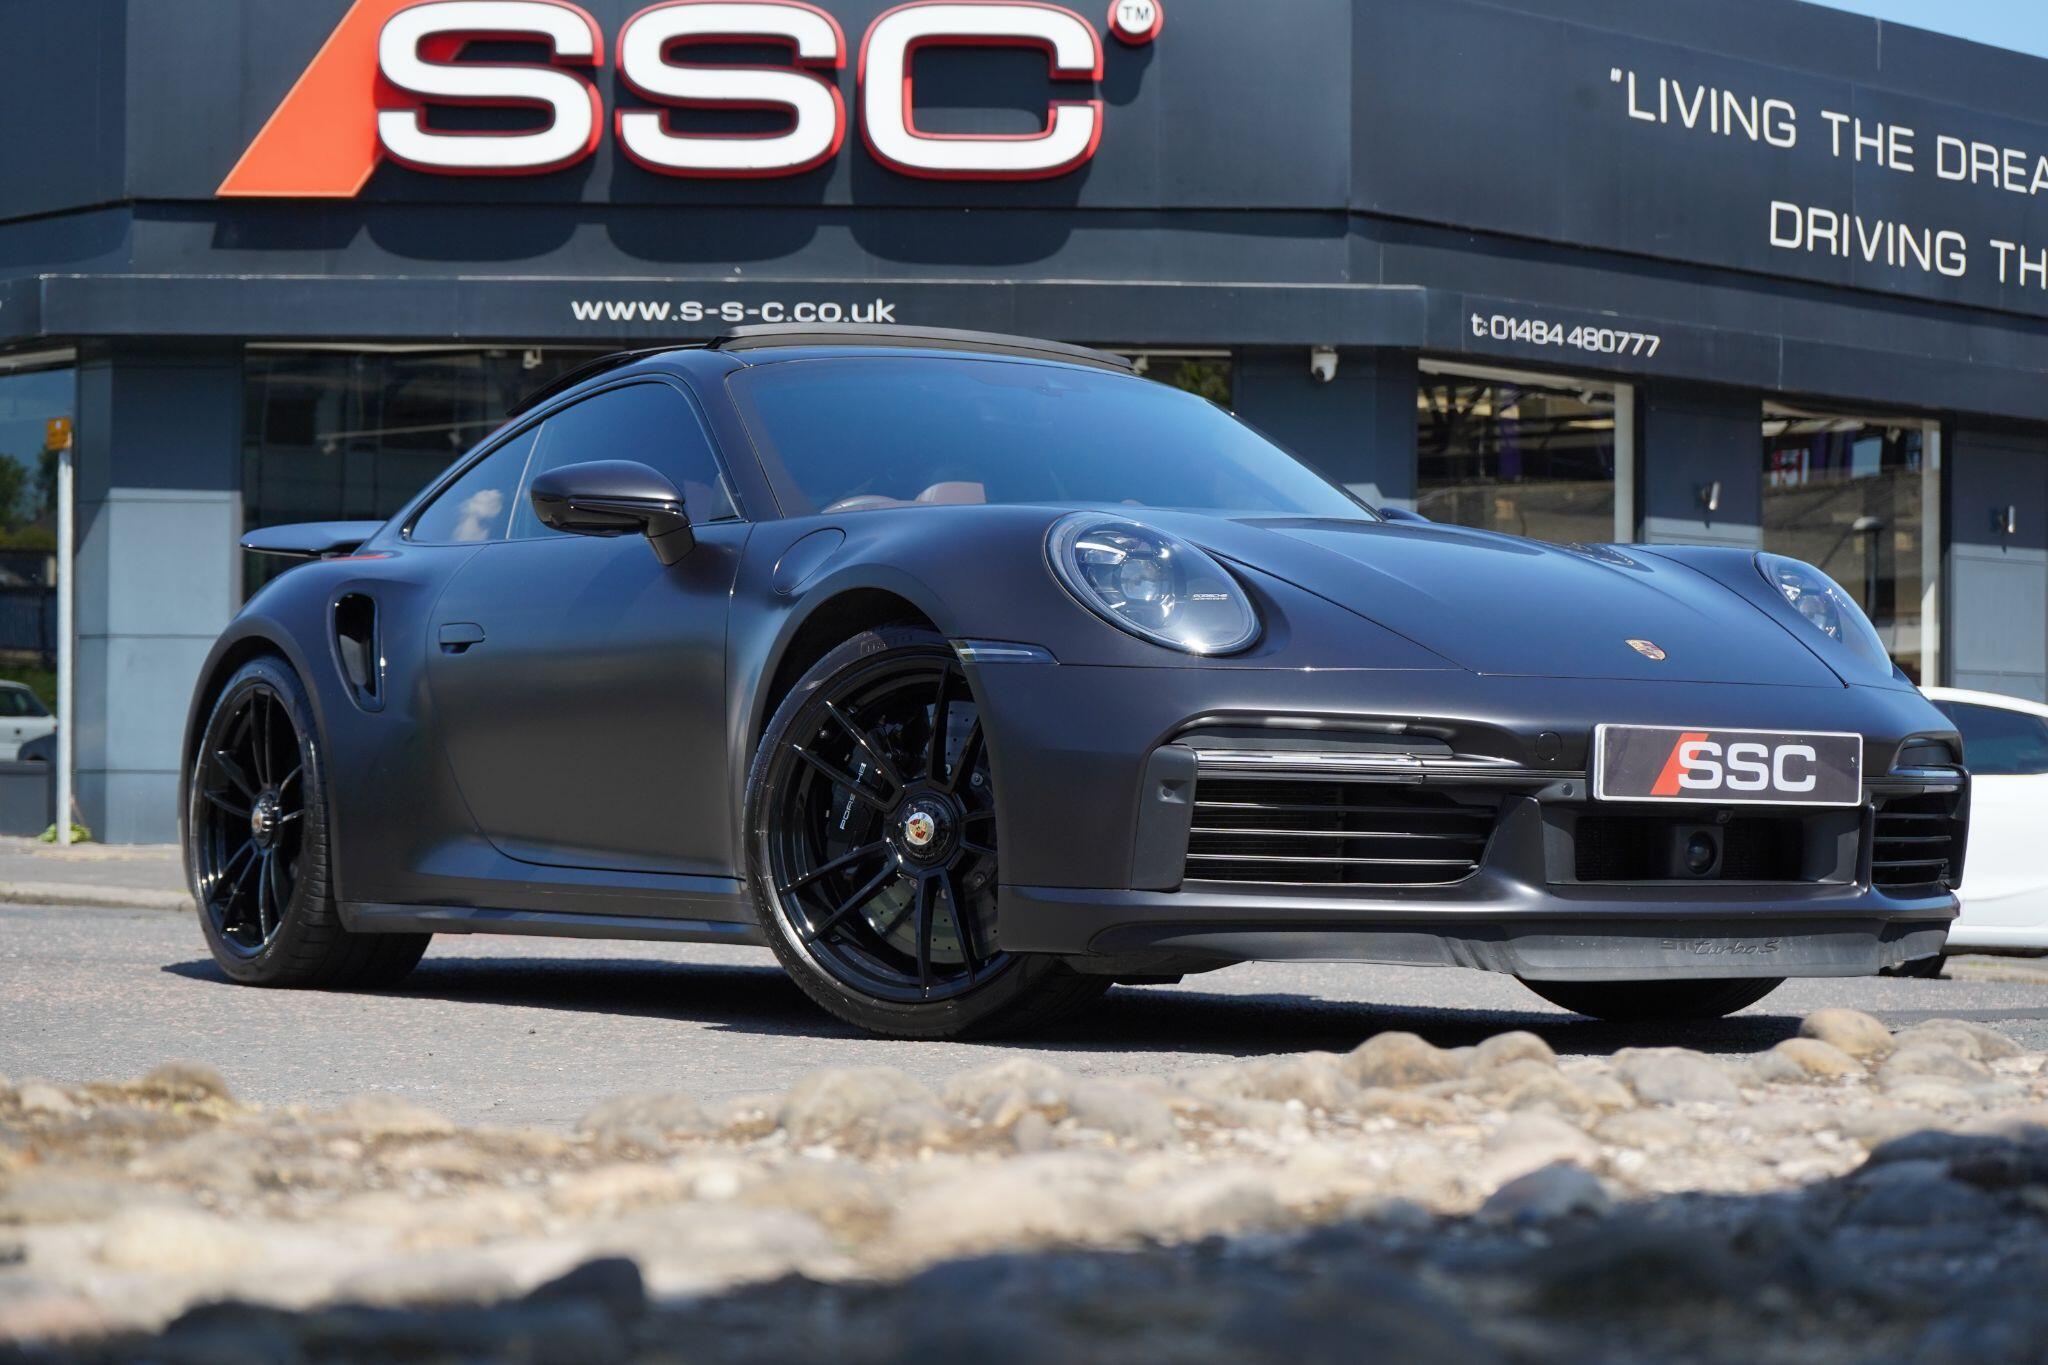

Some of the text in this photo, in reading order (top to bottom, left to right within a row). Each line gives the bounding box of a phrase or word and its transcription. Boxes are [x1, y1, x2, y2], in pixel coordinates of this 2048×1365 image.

[1123, 6, 1149, 21] TM
[374, 0, 1104, 176] SSC
[1821, 110, 1915, 172] THE
[1770, 200, 2048, 290] DRIVING TH
[571, 299, 896, 323] www.s-s-c.co.uk
[1566, 325, 1660, 358] 480777
[1677, 741, 1817, 792] SSC
[839, 762, 867, 831] PORSHE
